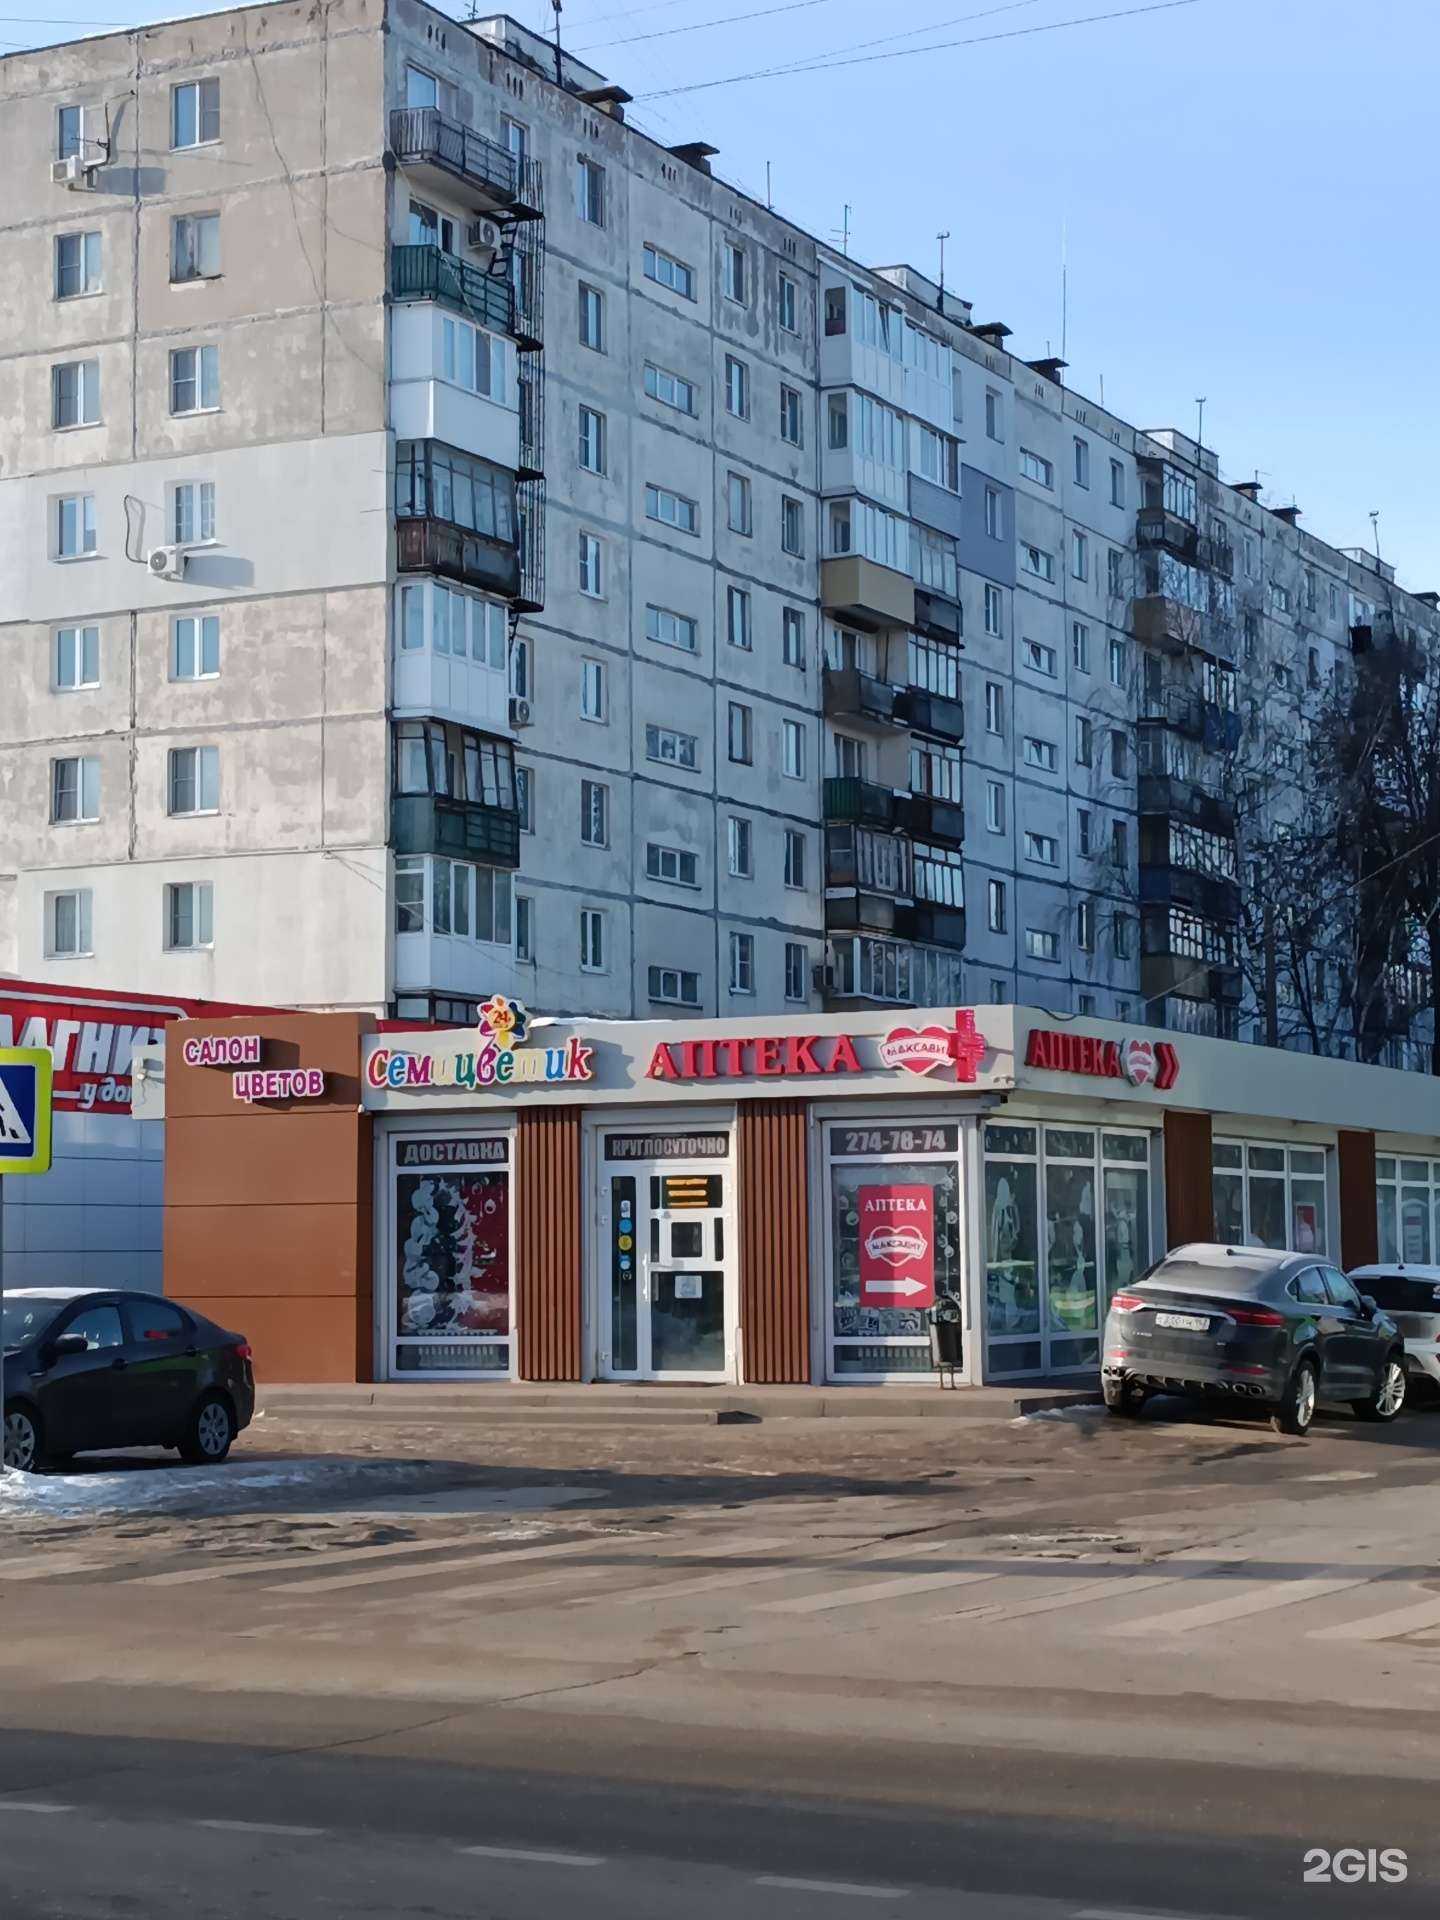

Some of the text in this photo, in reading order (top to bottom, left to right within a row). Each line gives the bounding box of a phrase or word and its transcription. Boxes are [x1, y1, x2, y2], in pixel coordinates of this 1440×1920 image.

[0, 1014, 165, 1074] АГНИ
[184, 1037, 260, 1065] САЛОН
[645, 1034, 863, 1079] АПТЕКА
[886, 1042, 948, 1057] МАКСАВИ
[1024, 1029, 1122, 1077] АПТЕКА
[100, 1077, 132, 1103] до
[233, 1070, 323, 1102] ЦВЕТОВ
[404, 1141, 505, 1164] ДОСТАВКА
[612, 1136, 726, 1156] КРУГЛОСУТОЧНО
[845, 1130, 946, 1152] 274-78-74
[864, 1198, 928, 1212] АПТЕКА
